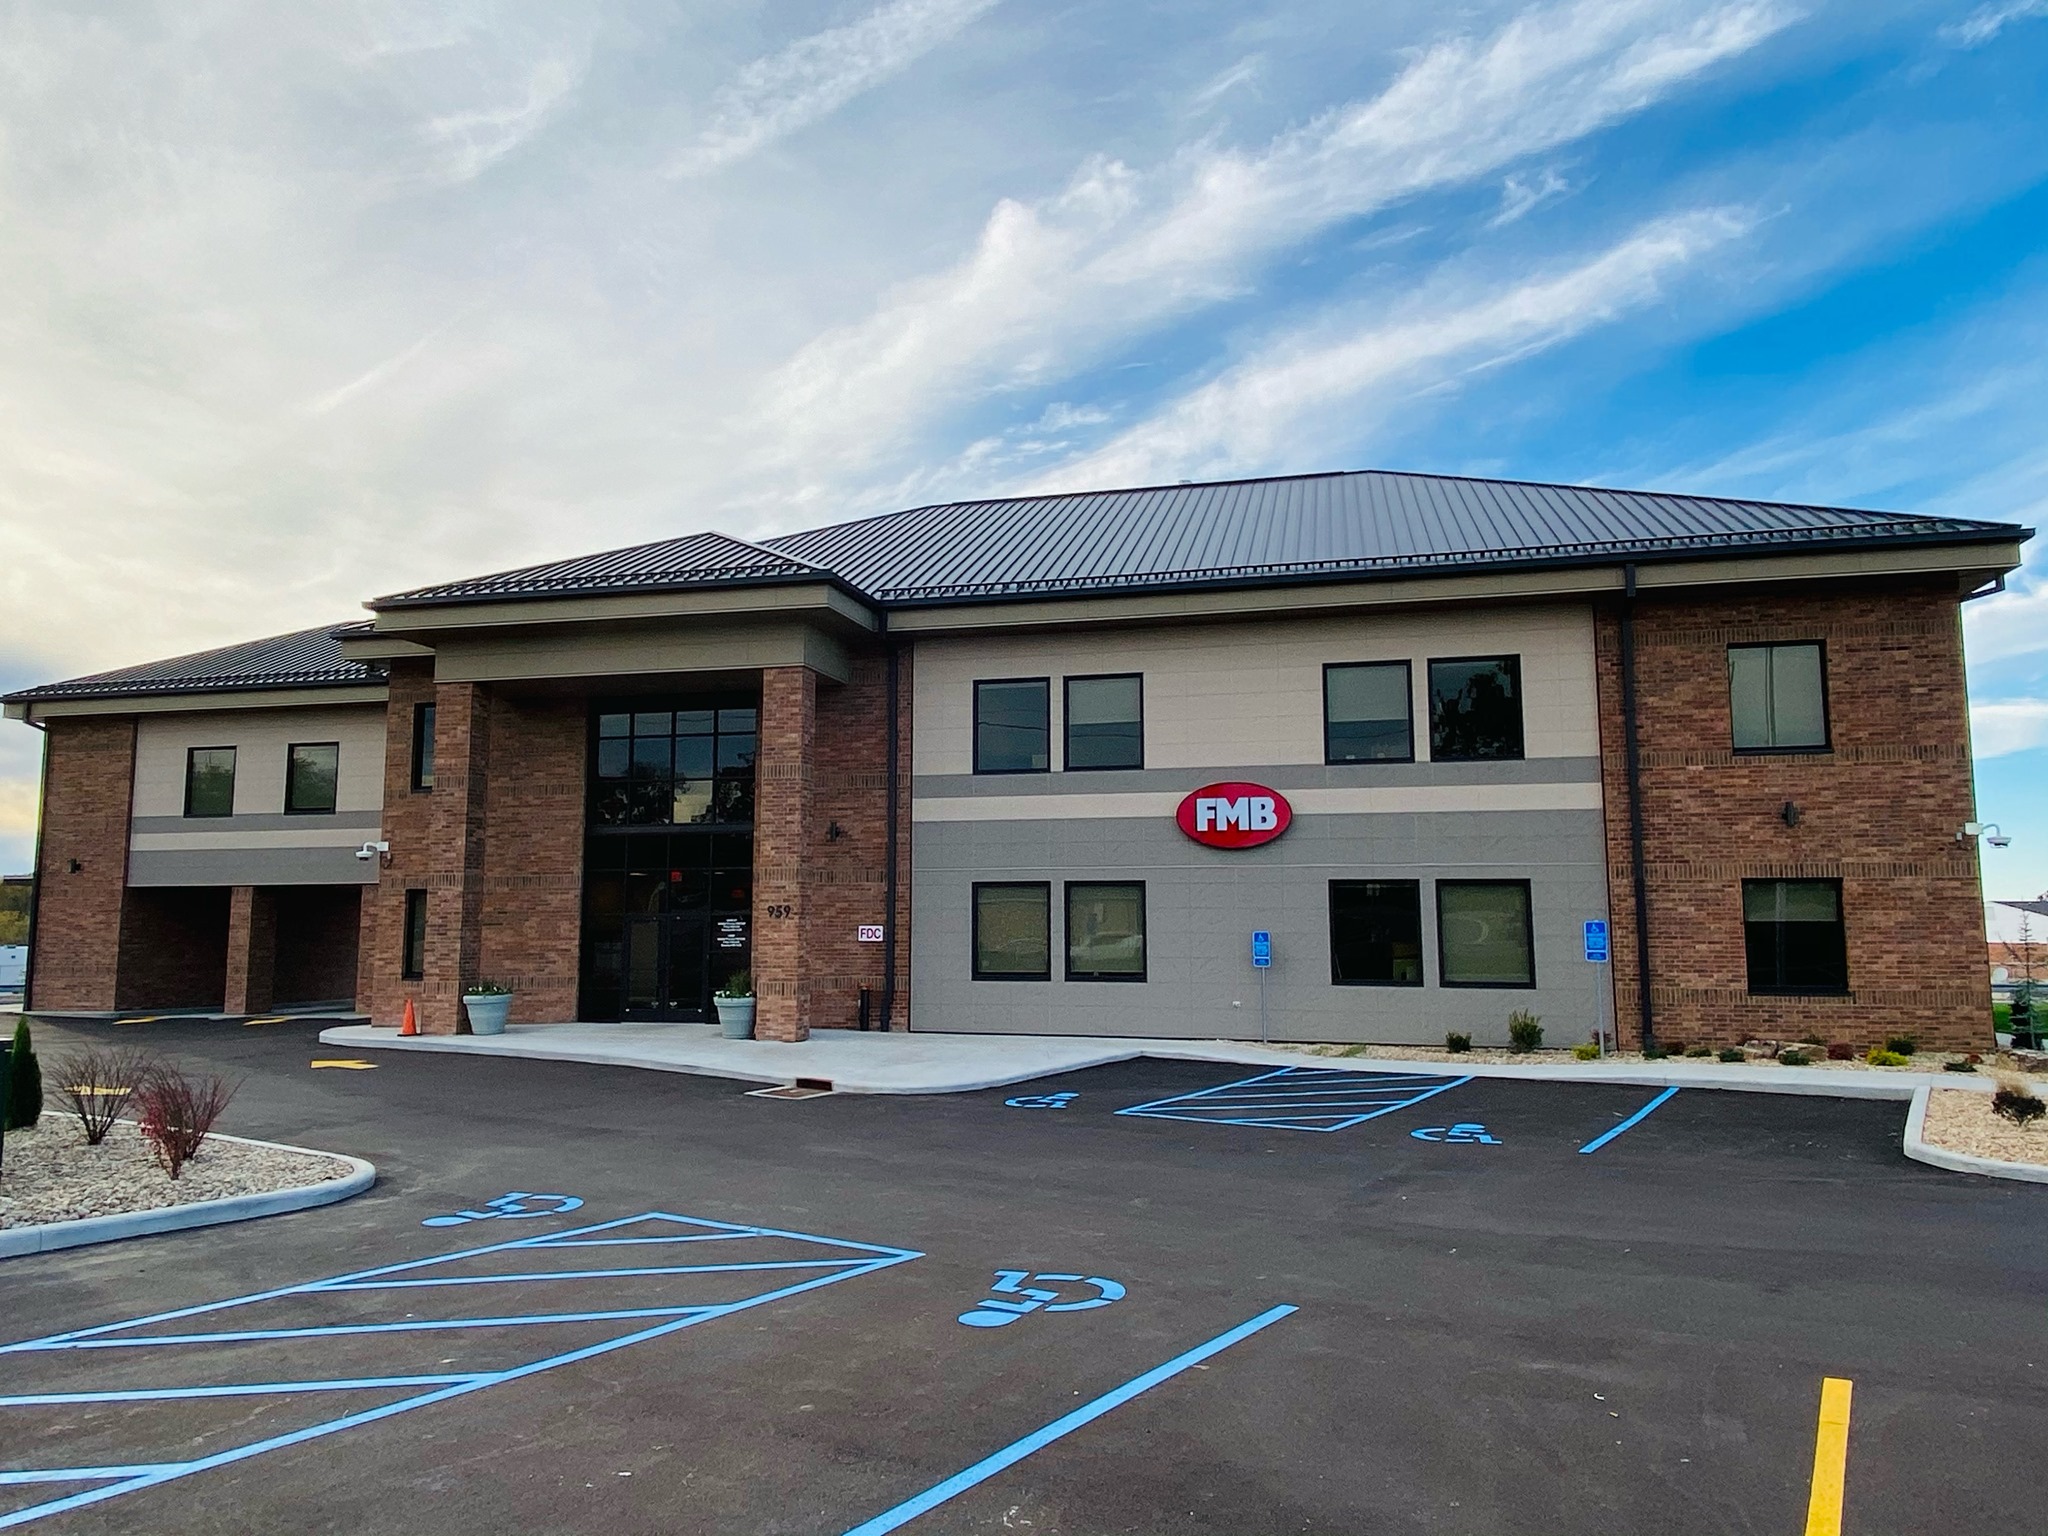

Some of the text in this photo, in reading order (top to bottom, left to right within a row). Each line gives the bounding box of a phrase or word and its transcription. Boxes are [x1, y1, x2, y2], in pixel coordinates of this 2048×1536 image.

[1196, 797, 1278, 831] FMB
[767, 905, 791, 918] 959
[860, 928, 881, 939] FDC
